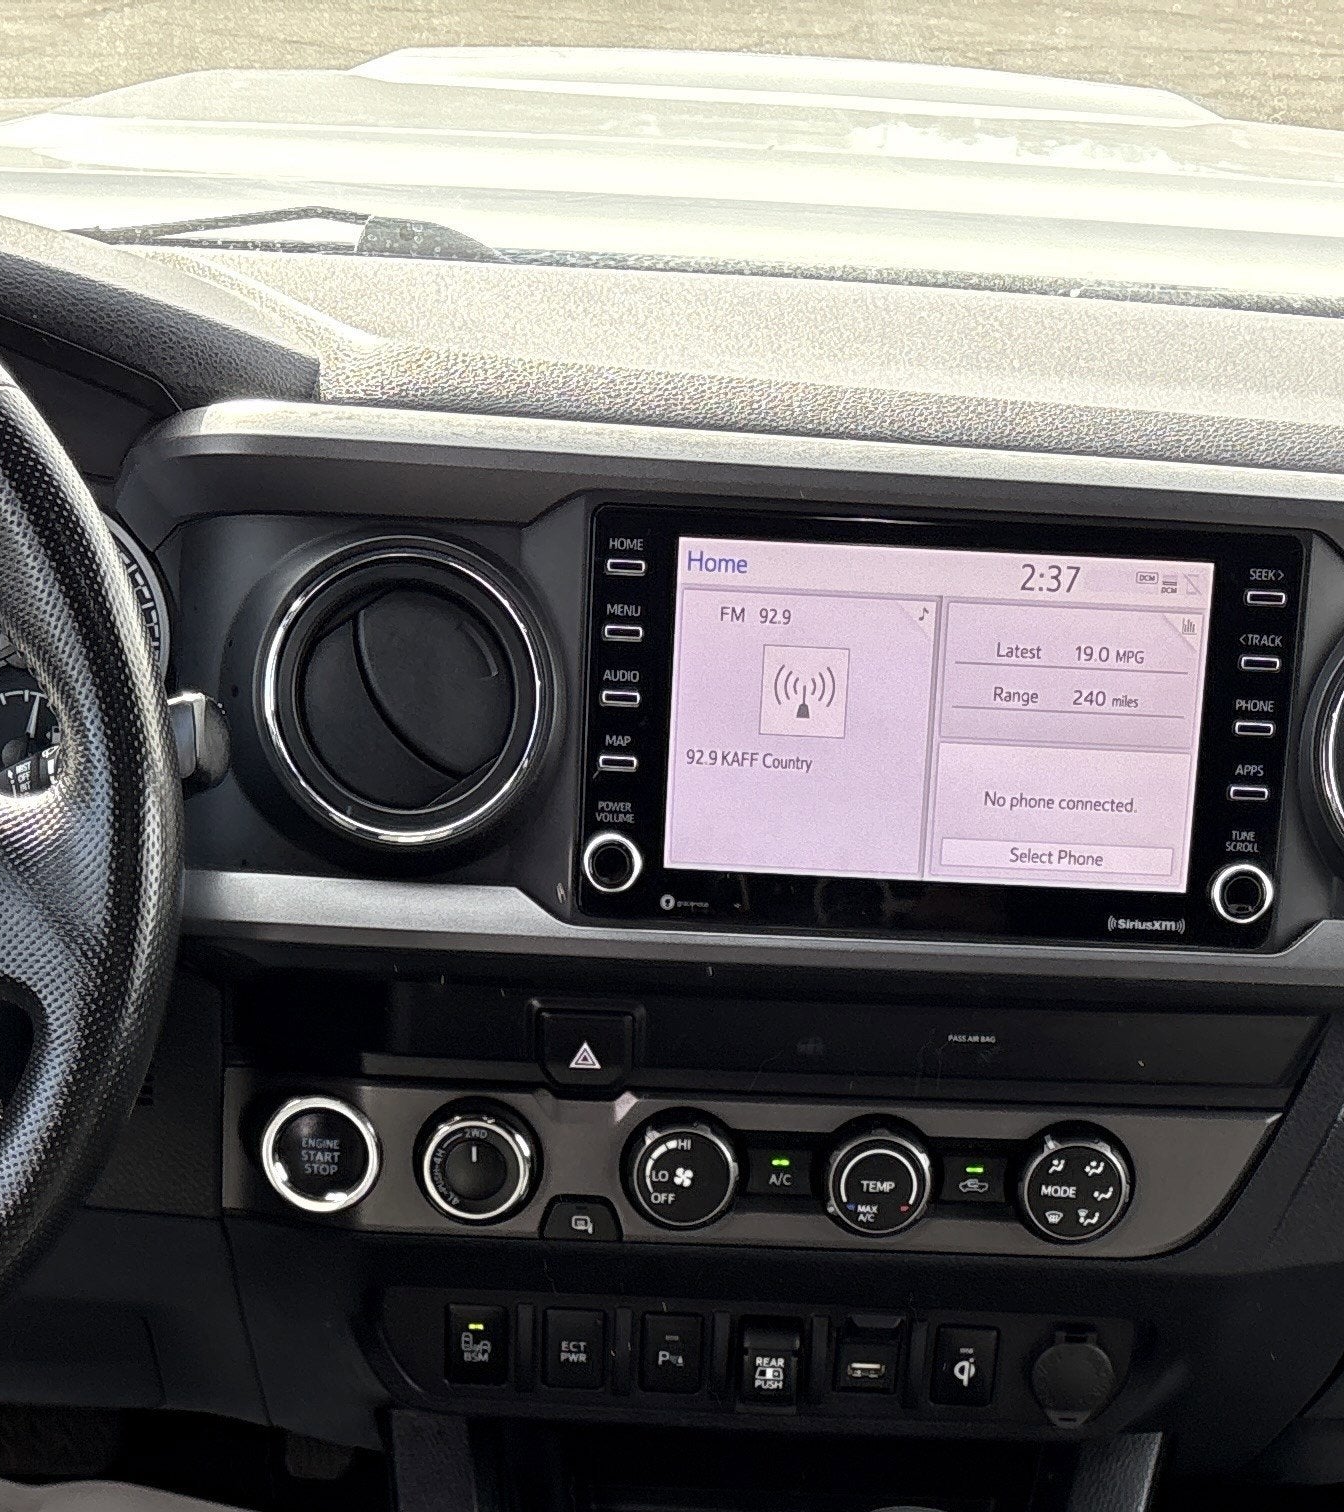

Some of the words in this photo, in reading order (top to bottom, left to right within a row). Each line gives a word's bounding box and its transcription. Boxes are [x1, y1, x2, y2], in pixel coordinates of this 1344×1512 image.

[609, 538, 644, 551] HOME
[687, 550, 748, 574] Home
[1020, 563, 1081, 593] 2:37
[606, 604, 641, 617] MENU
[720, 606, 746, 622] FM
[759, 607, 792, 625] 92.9
[996, 642, 1042, 660] Latest
[1075, 645, 1110, 663] 19.0
[1115, 650, 1145, 664] MPG
[603, 670, 640, 683] AUDIO
[993, 686, 1039, 707] Range
[1072, 690, 1107, 707] 240
[1111, 695, 1139, 709] miles
[1235, 699, 1275, 713] PHONE
[606, 735, 632, 747] MAP
[686, 749, 718, 766] 92.9
[721, 751, 759, 768] KAFF
[762, 753, 813, 773] Country
[1235, 765, 1264, 777] APPS
[598, 802, 632, 812] POWER
[984, 791, 1006, 808] No
[1009, 792, 1055, 811] phone
[1058, 798, 1138, 814] connected.
[595, 812, 635, 824] VOLUME
[1231, 830, 1256, 841] TUNE
[1225, 841, 1260, 853] SCROLL
[1009, 847, 1053, 865] Select
[1057, 849, 1104, 867] Phone
[948, 1034, 966, 1043] PASS
[464, 1129, 488, 1139] 2WD
[301, 1138, 340, 1150] ENGINE
[677, 1139, 692, 1150] HI
[301, 1151, 340, 1164] START
[304, 1163, 338, 1176] STOP
[651, 1170, 669, 1182] LO
[768, 1173, 792, 1187] A/C
[860, 1180, 896, 1193] TEMP
[1041, 1185, 1076, 1198] MODE
[650, 1192, 675, 1205] OFF
[857, 1204, 878, 1214] MAX
[858, 1213, 875, 1223] A/C
[561, 1341, 586, 1352] ECT
[463, 1352, 489, 1363] BSM
[560, 1353, 587, 1363] PWR
[756, 1356, 784, 1368] REAR
[754, 1379, 783, 1390] PUSH
